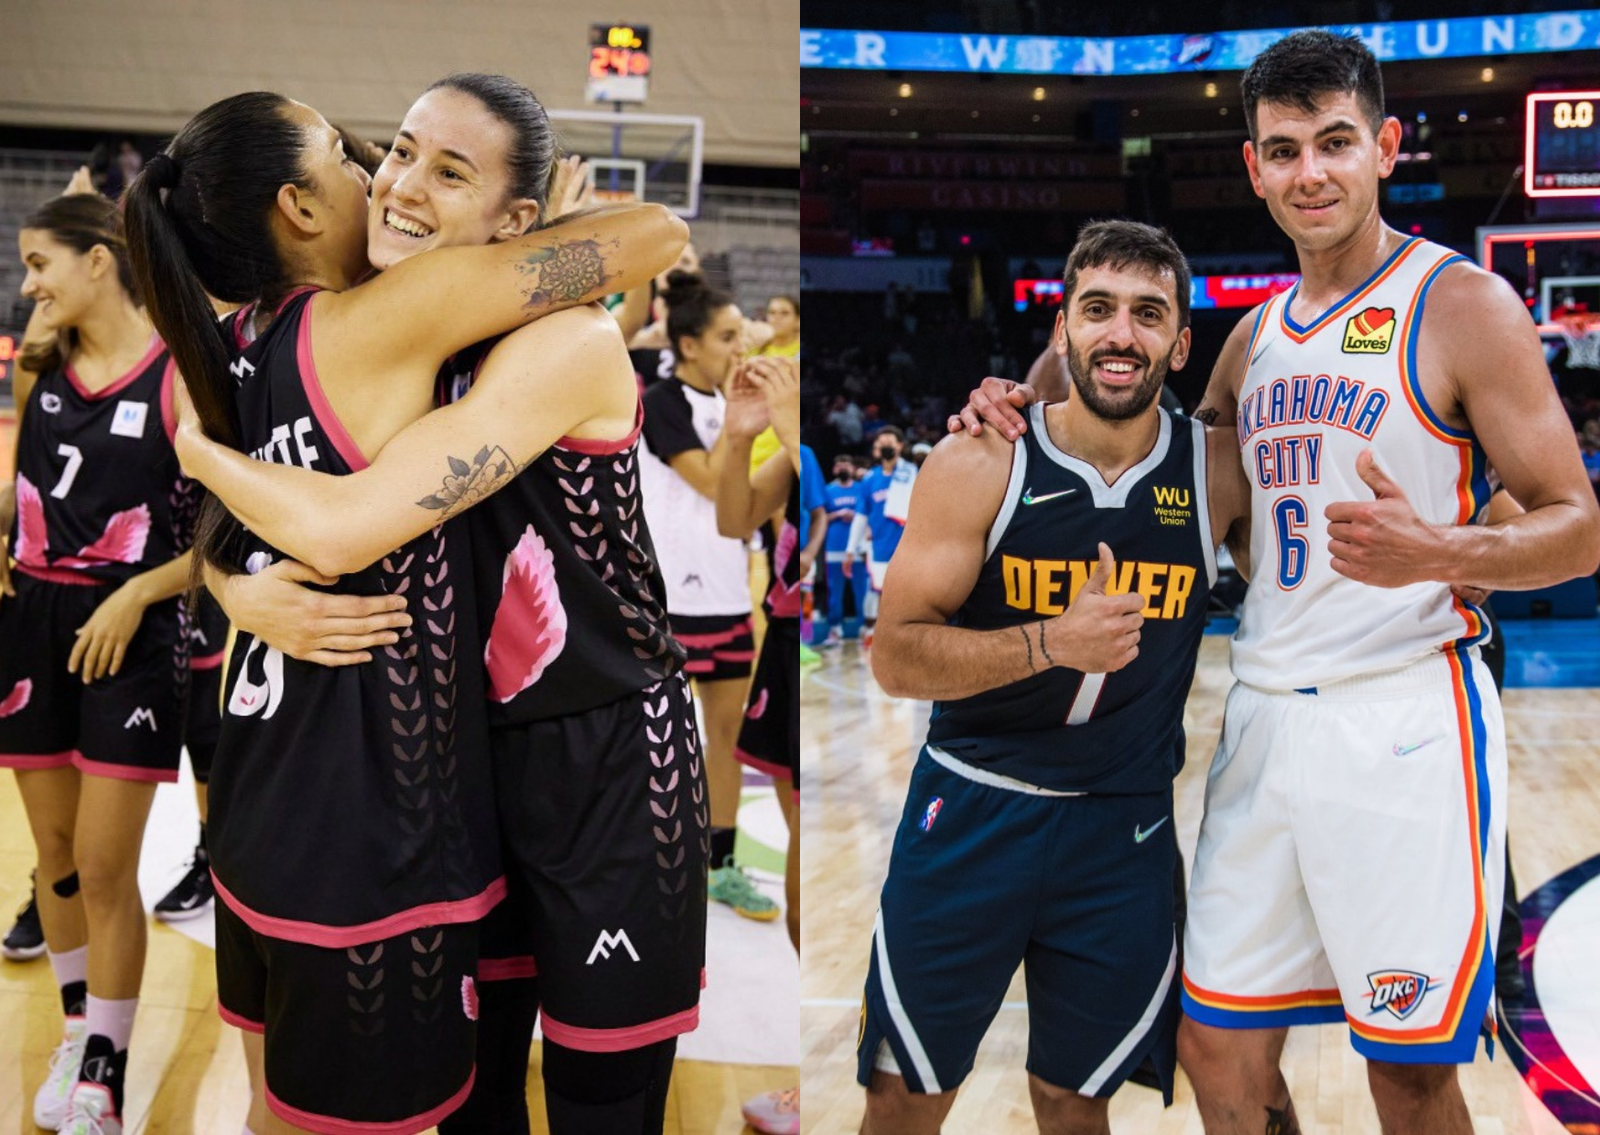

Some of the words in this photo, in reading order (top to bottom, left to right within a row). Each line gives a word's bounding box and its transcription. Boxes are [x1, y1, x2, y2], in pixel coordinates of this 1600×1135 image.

[1553, 101, 1594, 129] 0.0
[50, 443, 84, 500] 7
[1255, 433, 1322, 489] CITY
[1153, 486, 1189, 507] WU
[1154, 507, 1191, 517] Western
[1160, 516, 1186, 526] Union
[1272, 494, 1309, 591] 6
[1372, 979, 1414, 1008] OKC
